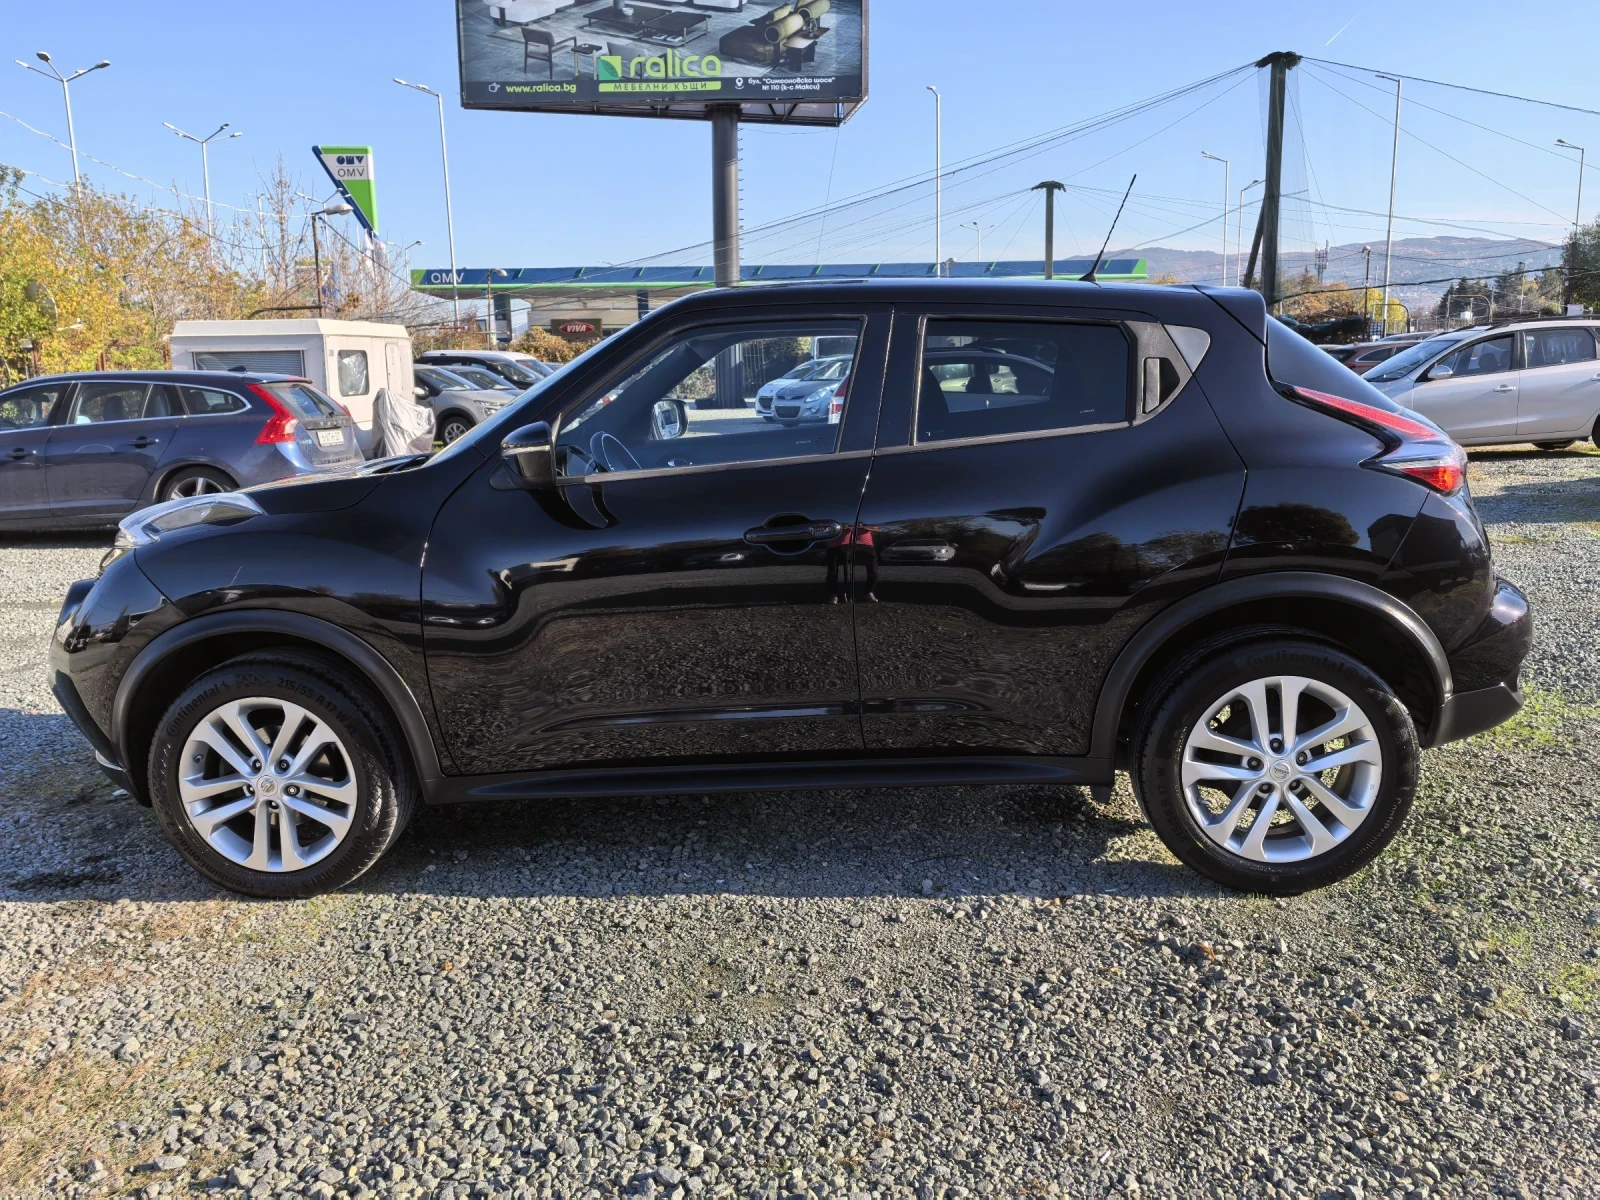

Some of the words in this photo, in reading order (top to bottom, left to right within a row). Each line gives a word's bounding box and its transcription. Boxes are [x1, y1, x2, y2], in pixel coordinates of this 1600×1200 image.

[630, 48, 721, 77] ralica
[505, 82, 577, 93] www.ralica.bg
[613, 83, 668, 91] МЕБЕЛНИ
[674, 82, 707, 91] КЪЩИ
[337, 168, 365, 178] OMV
[430, 272, 465, 284] OMV
[566, 324, 587, 332] VIVA
[276, 678, 315, 698] 215/55
[166, 682, 222, 737] Continental
